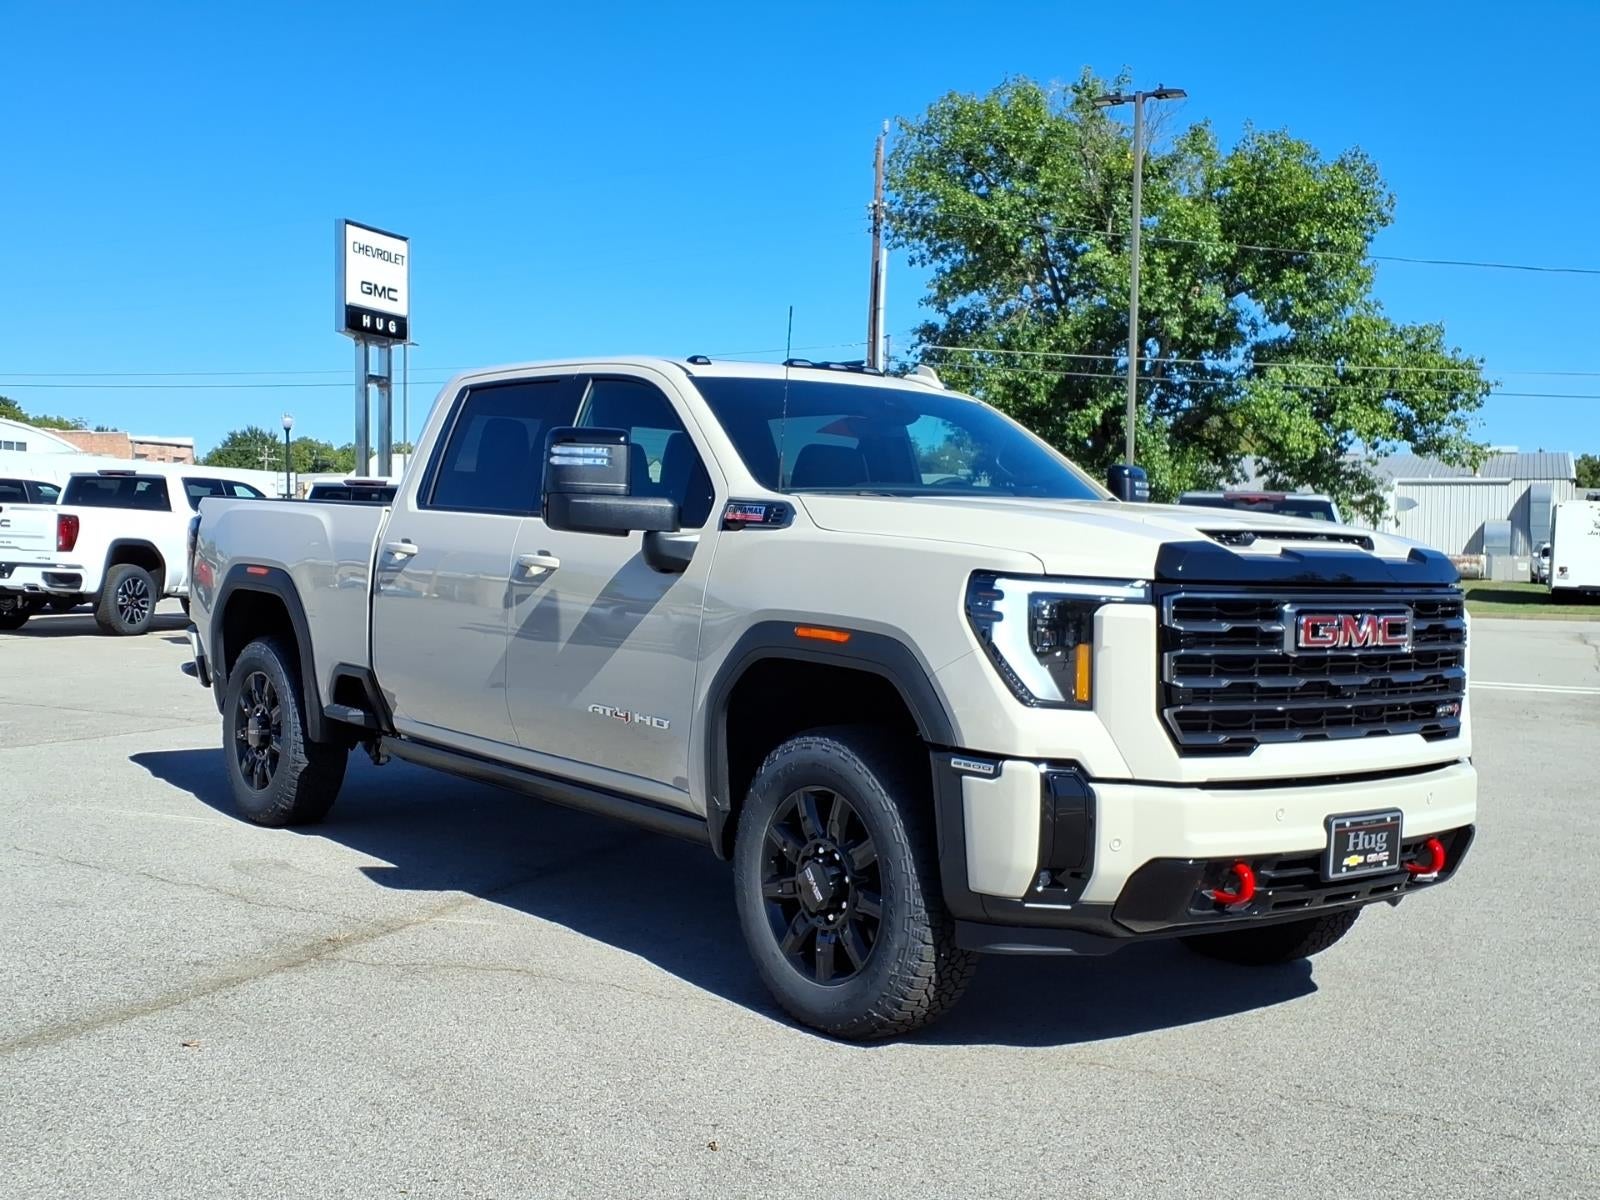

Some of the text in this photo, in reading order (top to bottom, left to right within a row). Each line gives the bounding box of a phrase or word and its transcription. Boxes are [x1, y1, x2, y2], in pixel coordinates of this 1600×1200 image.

[352, 240, 406, 267] CHEVROLET
[360, 280, 398, 302] GMC
[361, 314, 397, 333] HUG
[1299, 614, 1411, 648] GMC
[587, 703, 671, 730] AT4 HD
[1346, 830, 1389, 852] Hug
